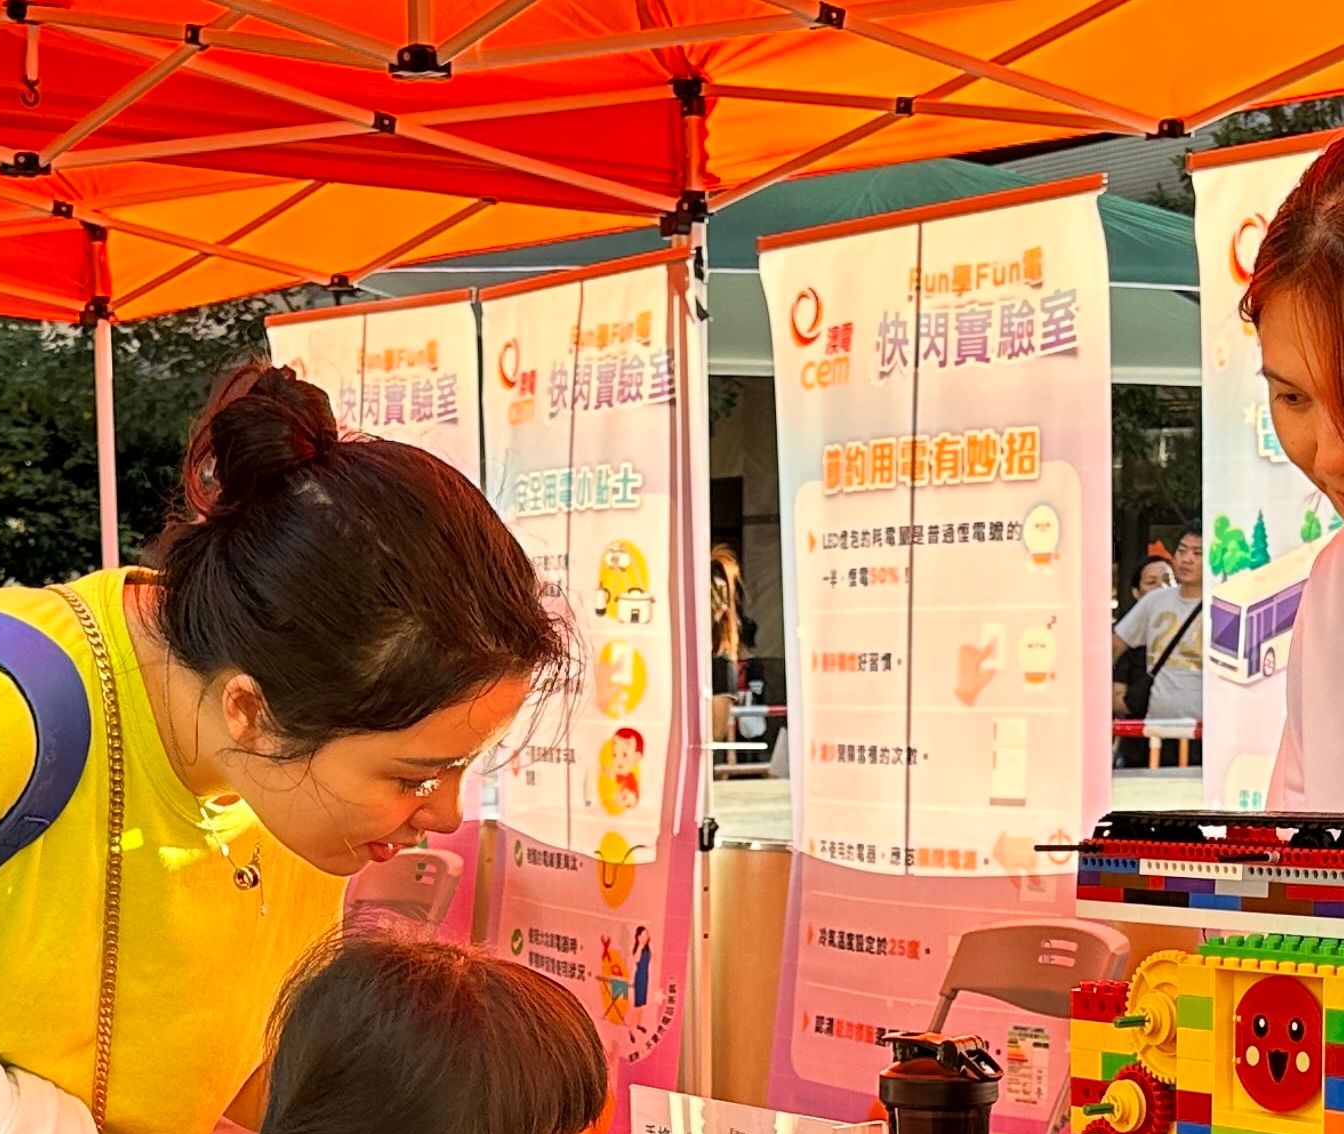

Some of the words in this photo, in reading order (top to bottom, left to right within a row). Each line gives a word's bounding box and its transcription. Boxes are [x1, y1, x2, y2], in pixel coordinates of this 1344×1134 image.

[876, 289, 1078, 368] 快閃實驗室
[801, 355, 850, 391] cem
